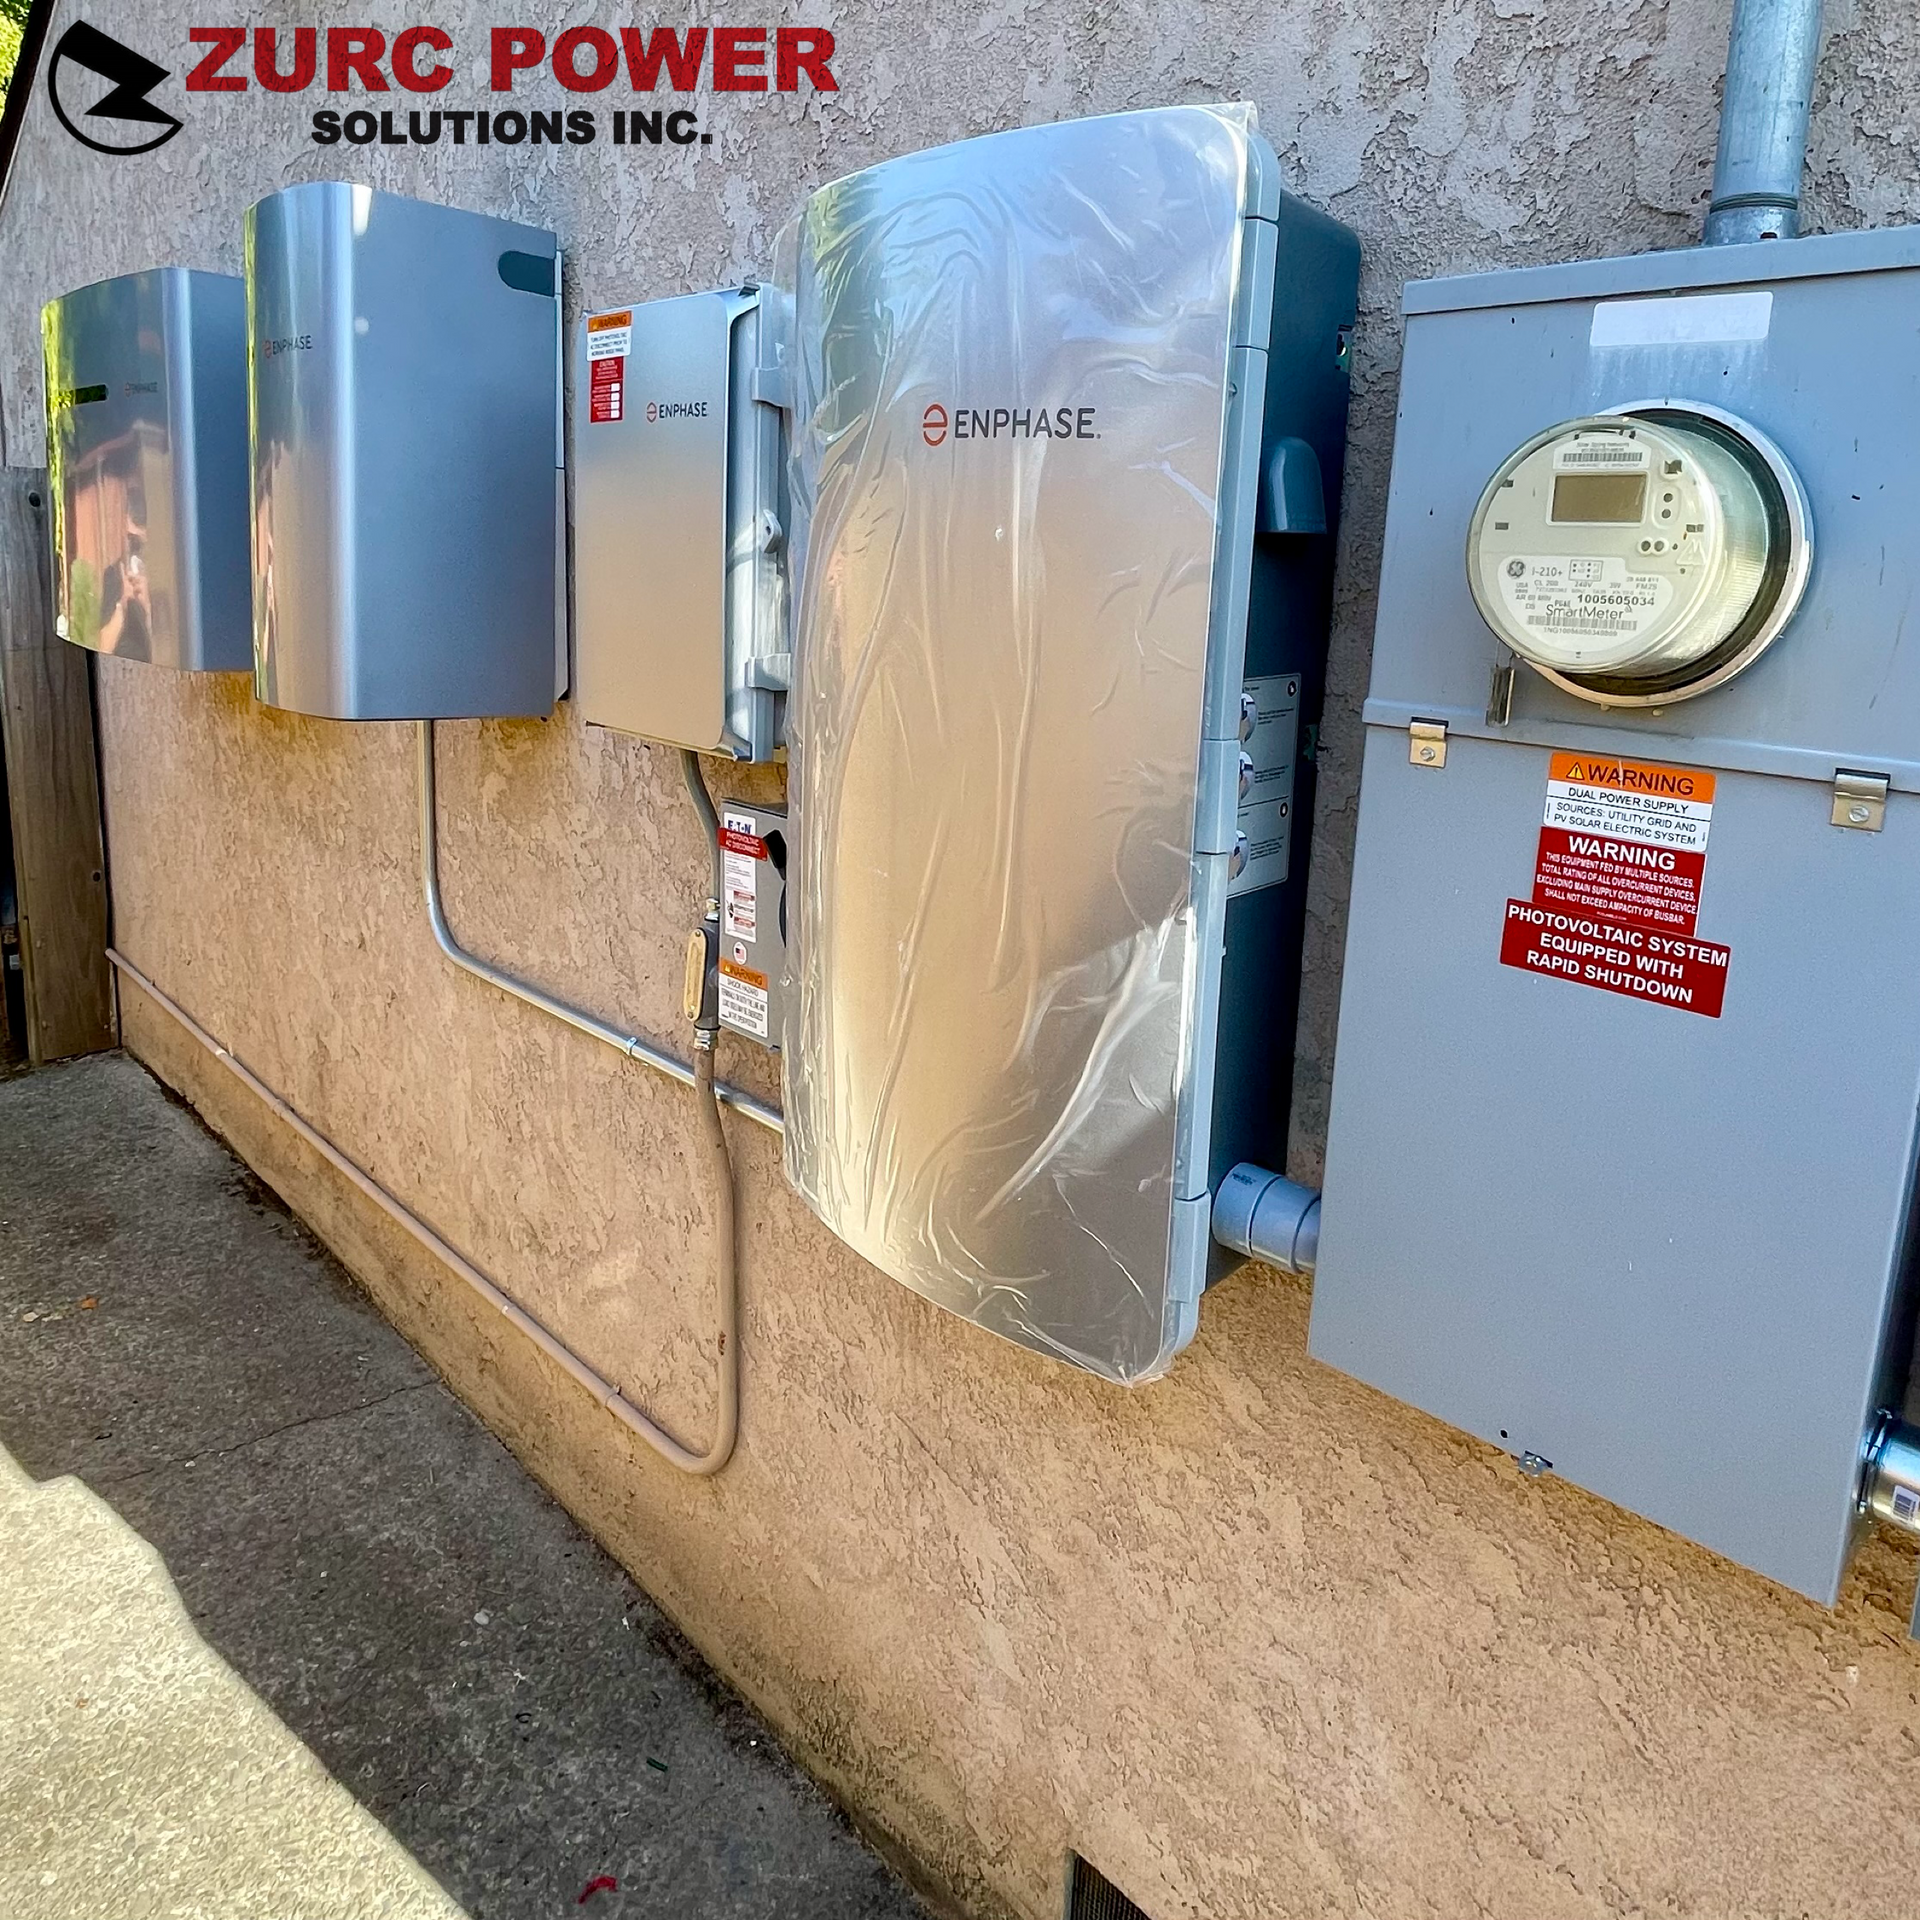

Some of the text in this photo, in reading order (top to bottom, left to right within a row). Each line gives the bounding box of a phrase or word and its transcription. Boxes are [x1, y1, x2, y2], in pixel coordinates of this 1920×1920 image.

[273, 334, 313, 354] ENPHASE
[659, 402, 708, 418] ENPHASE
[955, 408, 1095, 439] ENPHASE
[1546, 604, 1623, 620] SmartMeter
[1577, 593, 1655, 606] 1005605034
[1588, 763, 1694, 796] WARNING
[1568, 787, 1689, 814] DUAL POWER SUPPLY
[1553, 814, 1567, 824] PV
[1569, 816, 1601, 829] SOLAR
[1603, 822, 1651, 838] ELECTRIC
[1654, 829, 1696, 846] SYSTEM
[1556, 801, 1605, 817] SOURCES:
[1608, 809, 1645, 823] UTILITY
[1647, 817, 1672, 829] GRID
[1675, 821, 1696, 833] AND
[1546, 851, 1560, 863] THIS
[1561, 854, 1599, 872] EQUIPMENT
[1600, 861, 1613, 873] FED
[1614, 864, 1624, 874] BY
[1625, 865, 1658, 881] MULTIPLE
[1568, 835, 1676, 871] WARNING
[1536, 874, 1573, 890] EXCLUDING
[1574, 880, 1591, 892] MAIN
[1592, 882, 1617, 898] SUPPLY
[1617, 888, 1670, 908] OVERCURRENT
[1541, 863, 1562, 875] TOTAL
[1563, 866, 1587, 880] RATING
[1587, 871, 1597, 881] OF
[1597, 872, 1611, 884] ALL
[1612, 876, 1663, 895] OVERCURRENT
[1544, 888, 1566, 900] SHALL
[1566, 892, 1580, 903] NOT
[1580, 894, 1608, 909] EXCEED
[1608, 901, 1643, 917] AMPACITY
[1643, 906, 1653, 917] OF
[1508, 904, 1727, 968] PHOTOVOLTAIC SYSTEM
[1540, 932, 1684, 980] EQUIPPED WITH
[1526, 950, 1693, 1004] RAPID SHUTDOWN
